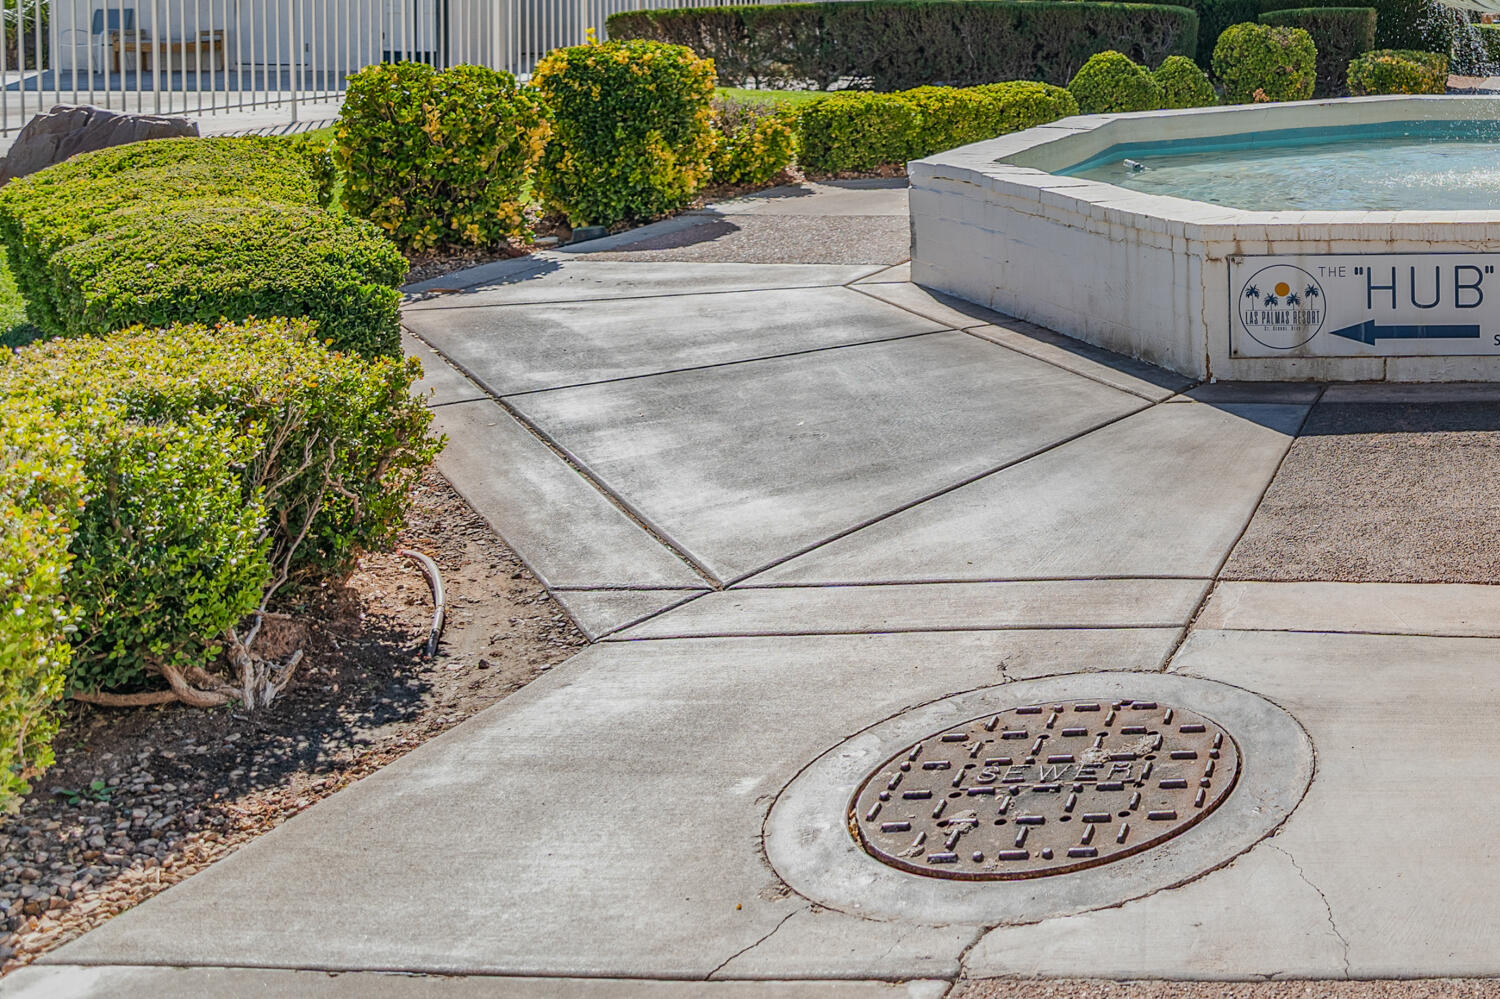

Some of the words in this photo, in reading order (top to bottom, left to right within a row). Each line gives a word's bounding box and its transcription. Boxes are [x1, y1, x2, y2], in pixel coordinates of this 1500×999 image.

[1318, 266, 1346, 278] THE
[1354, 265, 1494, 309] "HUB"
[1245, 311, 1259, 325] LAS
[1261, 310, 1290, 325] PALMAS
[1292, 310, 1320, 325] RESORT
[976, 762, 1132, 784] SEWER
